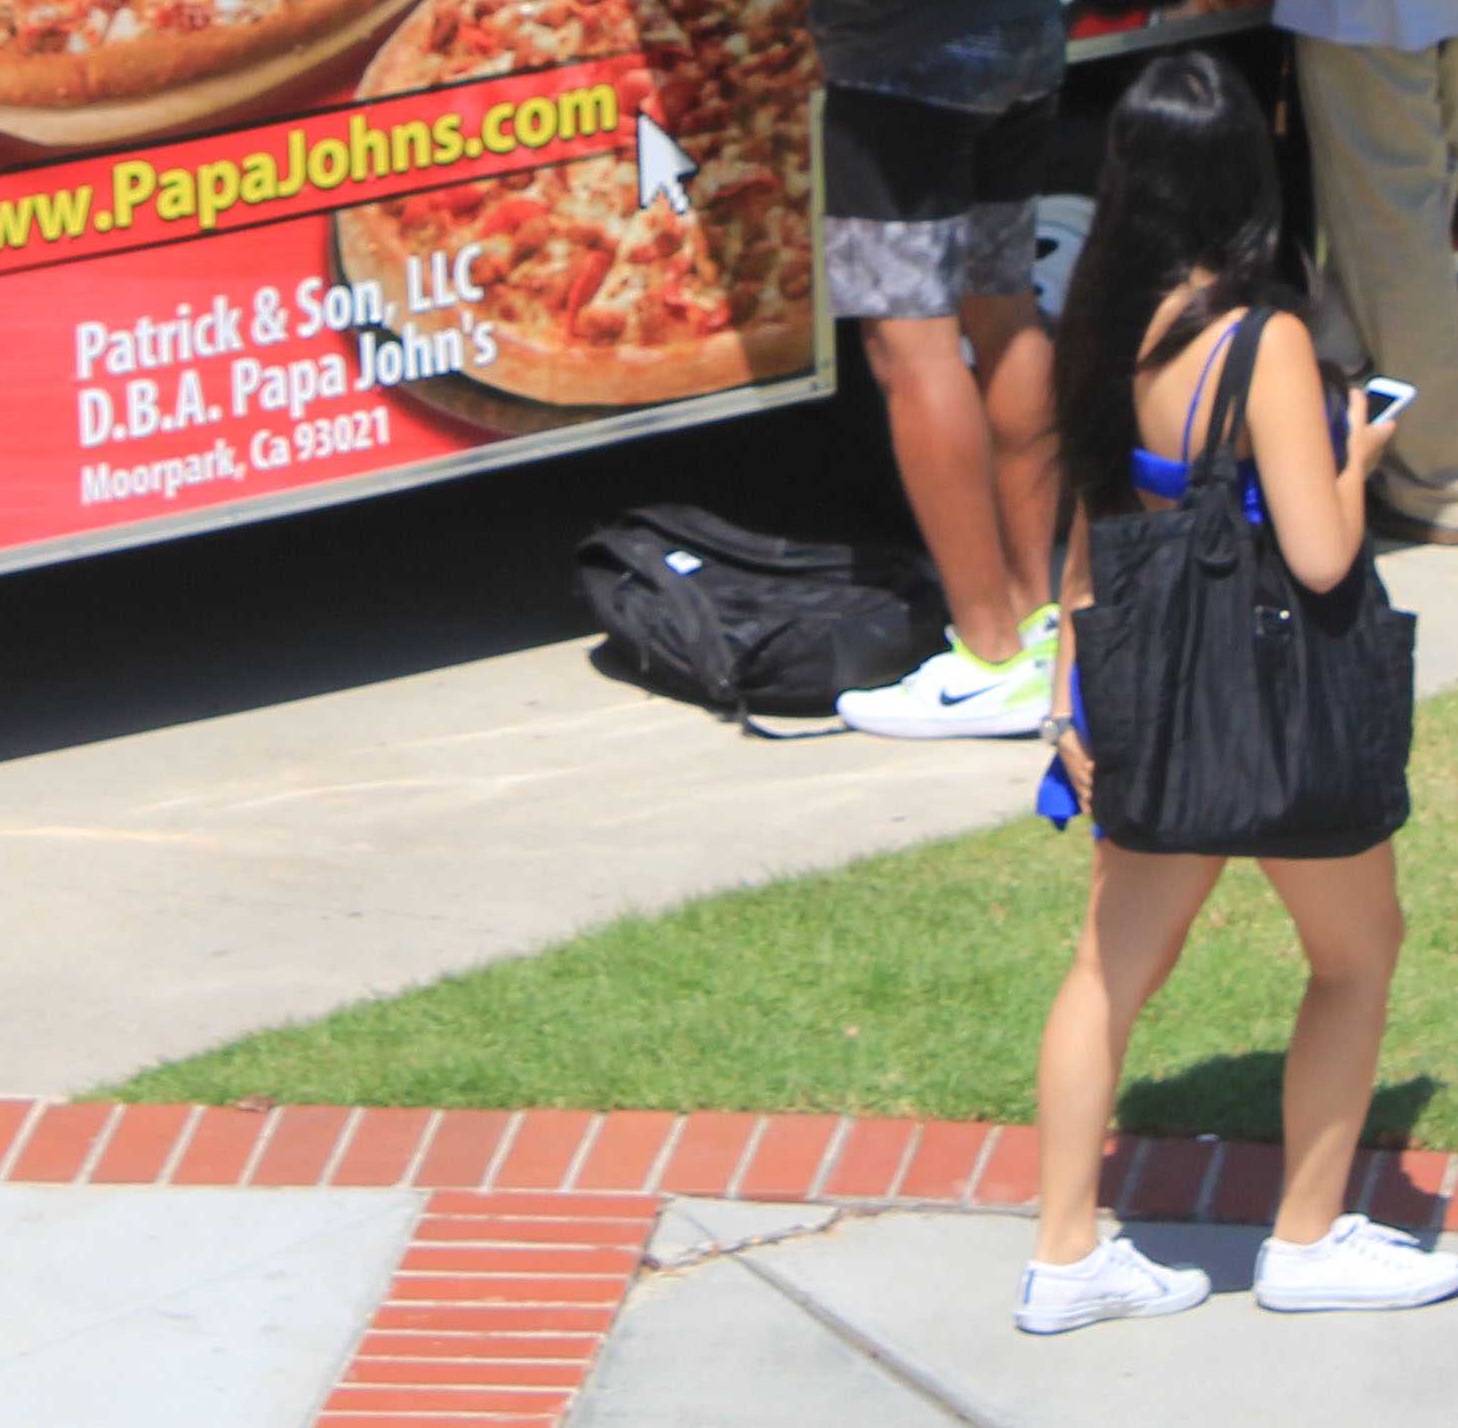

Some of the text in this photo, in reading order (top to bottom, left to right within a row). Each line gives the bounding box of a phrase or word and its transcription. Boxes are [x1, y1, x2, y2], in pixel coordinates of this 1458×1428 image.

[75, 244, 485, 383] Patrick & Son, LLC
[78, 309, 498, 449] D.B.A. Papa John's
[80, 404, 392, 507] Moorpark, Ca 93021
